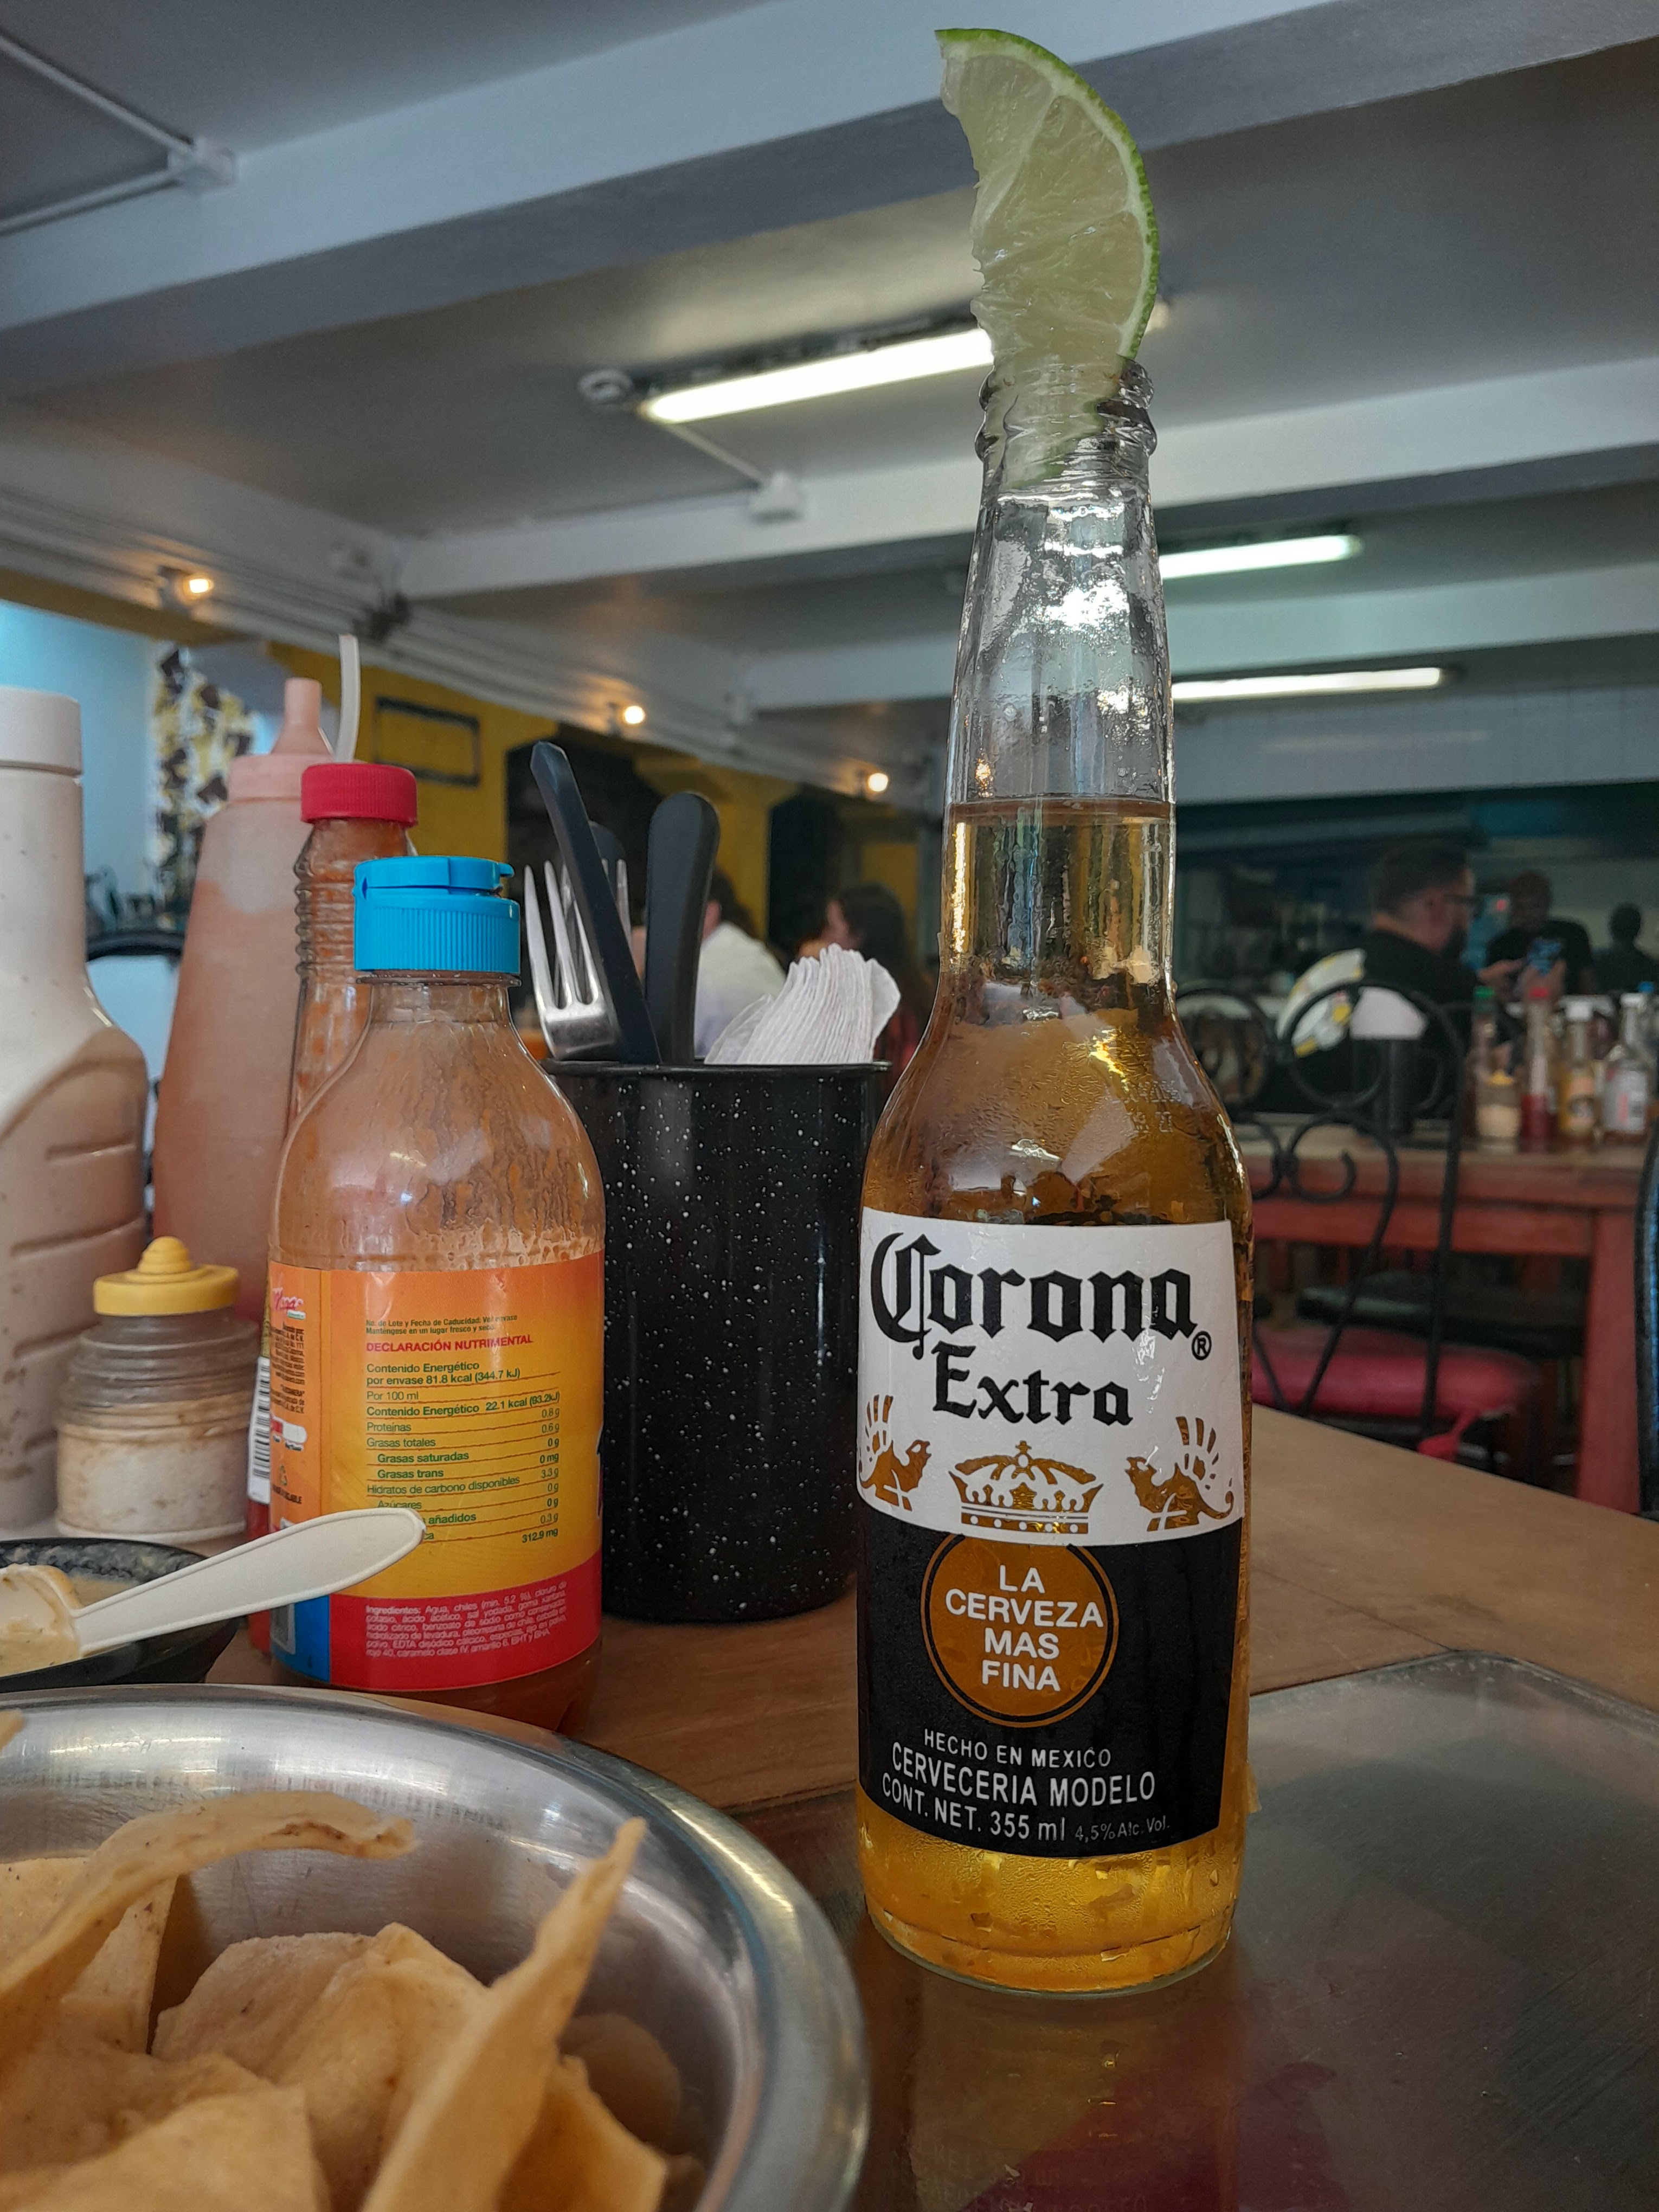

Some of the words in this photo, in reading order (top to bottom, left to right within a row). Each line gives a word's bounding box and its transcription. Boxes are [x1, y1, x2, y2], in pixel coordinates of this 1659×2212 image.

[870, 1232, 1198, 1360] Corona
[495, 1314, 518, 1322] envase
[430, 1326, 448, 1335] lugar
[366, 1338, 451, 1352] DECLARACIÓN
[454, 1334, 533, 1351] NUTRIMENTAL
[366, 1363, 420, 1373] Contenido
[423, 1361, 480, 1373] Energético
[366, 1377, 383, 1386] por
[426, 1375, 448, 1384] 81.8
[451, 1373, 472, 1383] kcal
[475, 1370, 504, 1383] (344.7
[931, 1340, 1133, 1425] Extra
[366, 1391, 383, 1400] Por
[387, 1391, 404, 1400] 100
[407, 1391, 419, 1400] ml
[366, 1406, 420, 1416] Contenido
[423, 1404, 480, 1417] Energético
[486, 1400, 505, 1411] 22.1
[508, 1397, 528, 1408] kcal
[366, 1422, 411, 1432] Proteínas
[542, 1408, 554, 1418] 0.8
[555, 1408, 560, 1418] g
[366, 1437, 401, 1447] Grasas
[403, 1438, 436, 1447] totales
[542, 1423, 554, 1433] 0.6
[555, 1423, 560, 1433] g
[377, 1453, 414, 1463] Grasas
[417, 1451, 470, 1463] saturadas
[548, 1438, 553, 1447] 0
[554, 1438, 560, 1448] g
[377, 1469, 414, 1478] Grasas
[417, 1469, 444, 1478] trans
[539, 1455, 545, 1464] 0
[546, 1454, 559, 1463] mg
[367, 1484, 407, 1494] Hidratos
[409, 1484, 422, 1494] de
[425, 1483, 466, 1493] carbono
[468, 1476, 520, 1491] disponibles
[541, 1468, 552, 1478] 3.3
[554, 1468, 559, 1478] g
[548, 1483, 552, 1492] 0
[554, 1483, 558, 1493] g
[428, 1513, 477, 1525] añadidos
[547, 1497, 552, 1507] 0
[554, 1498, 558, 1507] g
[553, 1513, 558, 1523] g
[522, 1530, 544, 1544] 312.9
[546, 1528, 558, 1538] mg
[1000, 1565, 1045, 1593] LA
[946, 1588, 1104, 1628] CERVEZA
[985, 1627, 1060, 1660] MAS
[982, 1659, 1060, 1692] FINA
[924, 1728, 987, 1760] HECHO
[996, 1745, 1022, 1766] EN
[1032, 1748, 1111, 1769] MEXICO
[892, 1741, 1038, 1806] CERVECERIA
[1050, 1771, 1155, 1806] MODELO
[882, 1772, 928, 1817] CONT.
[935, 1797, 981, 1832] NET.
[990, 1811, 1030, 1839] 355
[1038, 1817, 1065, 1841] ml
[1146, 1815, 1171, 1833] Vol.
